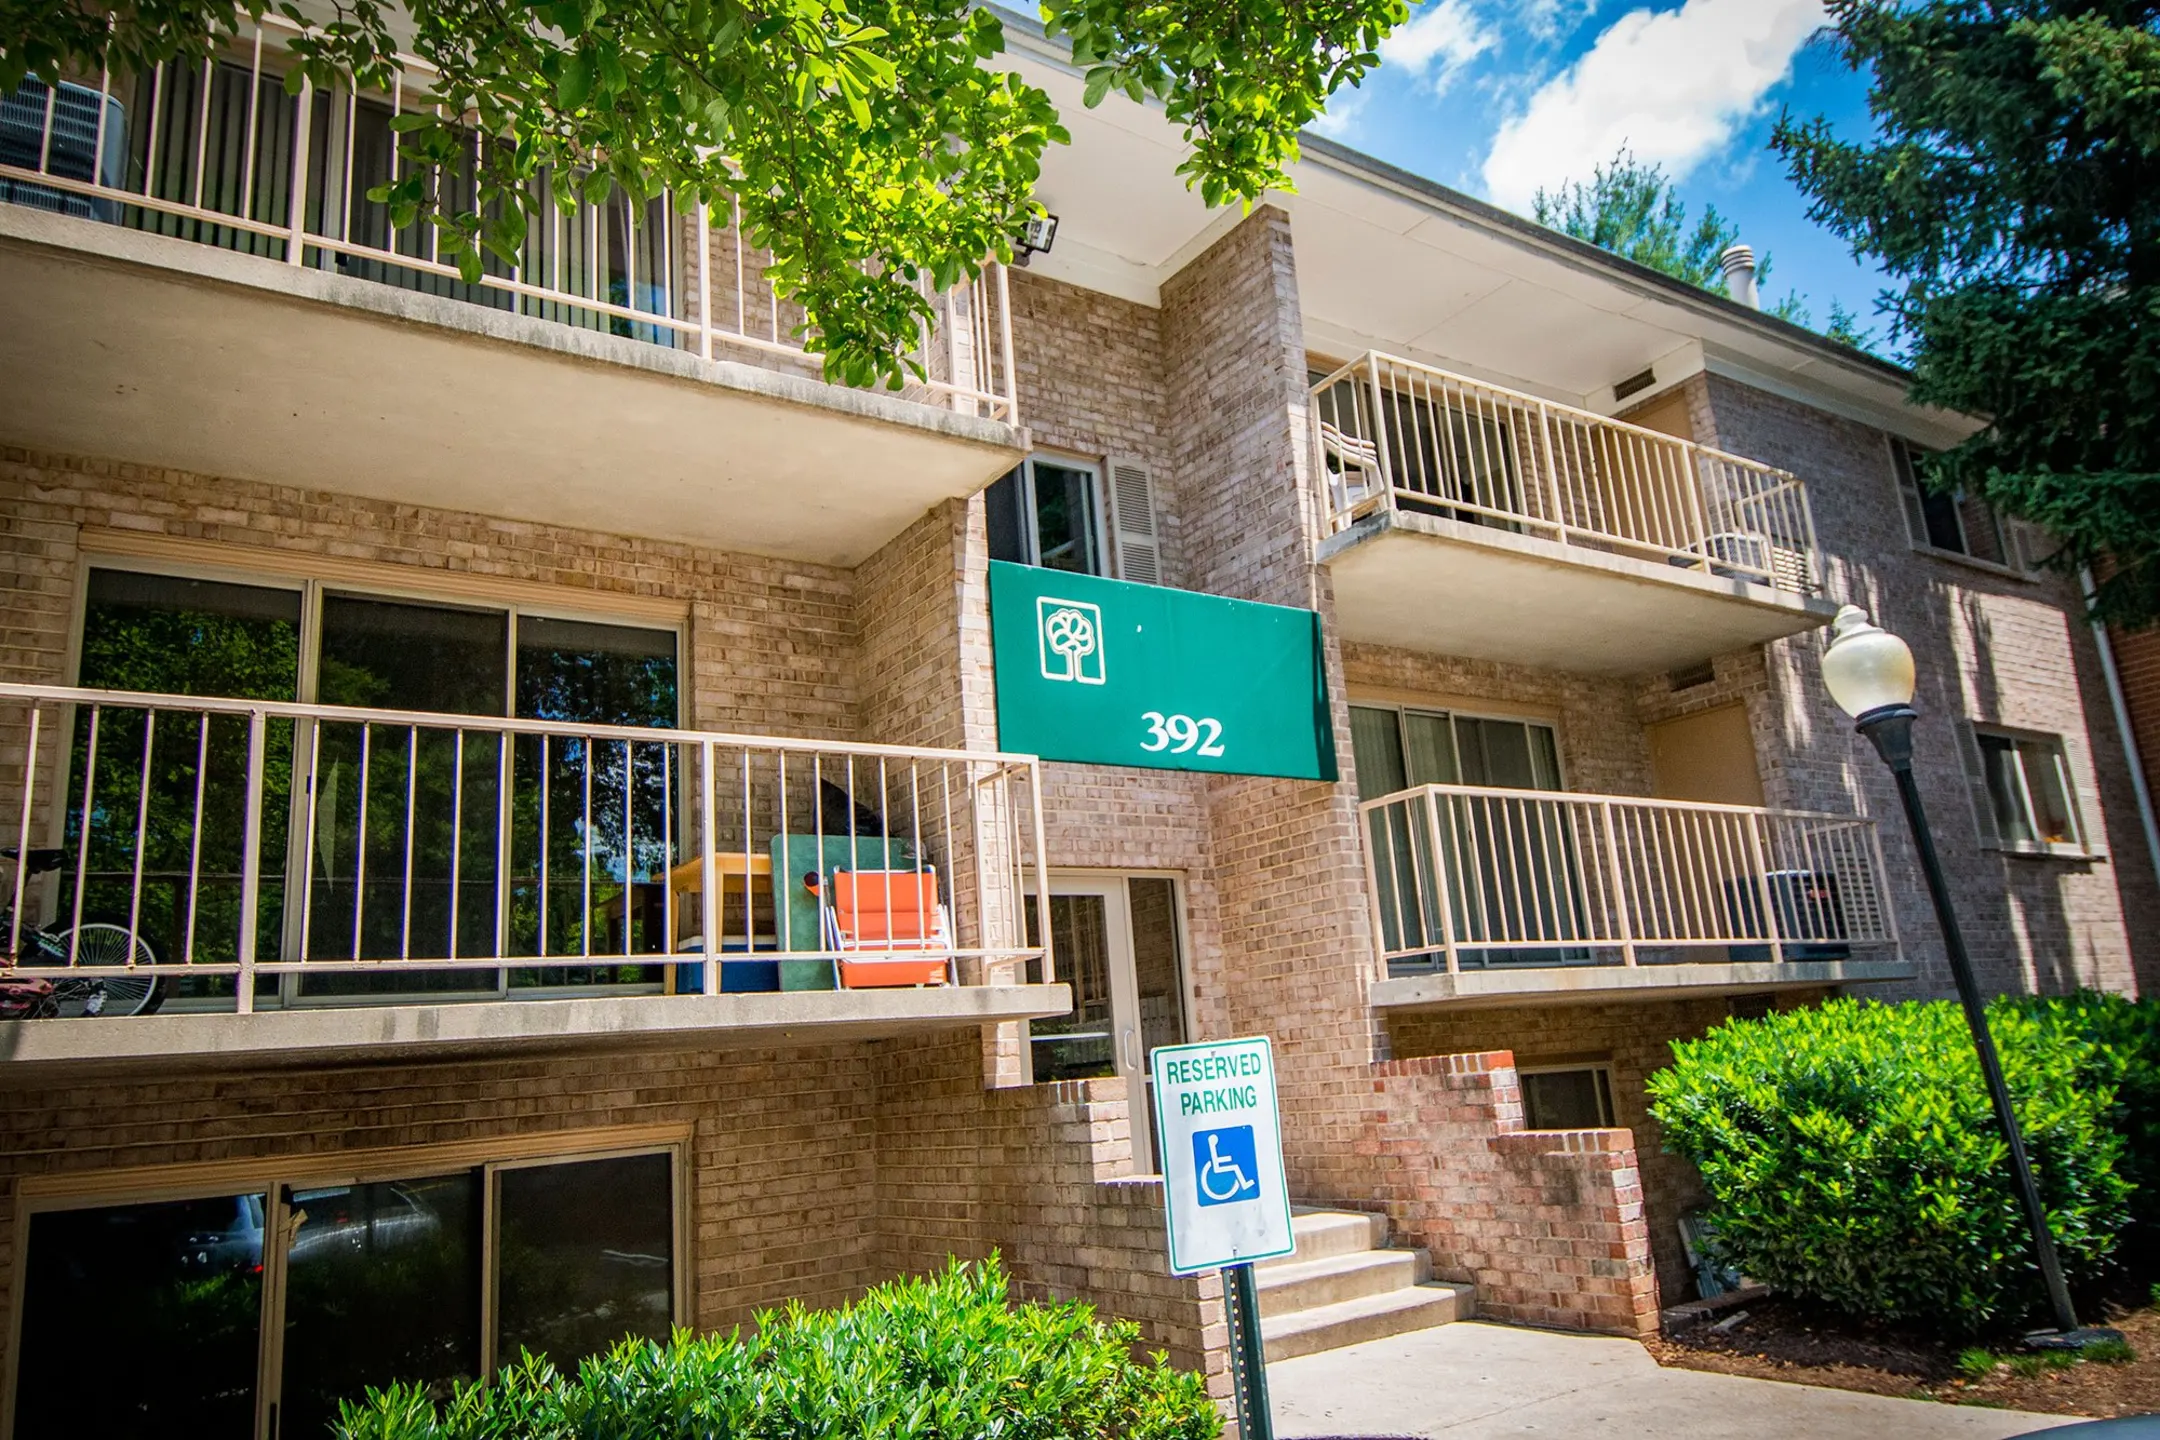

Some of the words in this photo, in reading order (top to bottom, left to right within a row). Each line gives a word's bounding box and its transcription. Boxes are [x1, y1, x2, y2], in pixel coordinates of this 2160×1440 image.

[1140, 711, 1224, 757] 392
[1166, 1052, 1261, 1084] RESERVED
[1181, 1085, 1256, 1116] PARKING
